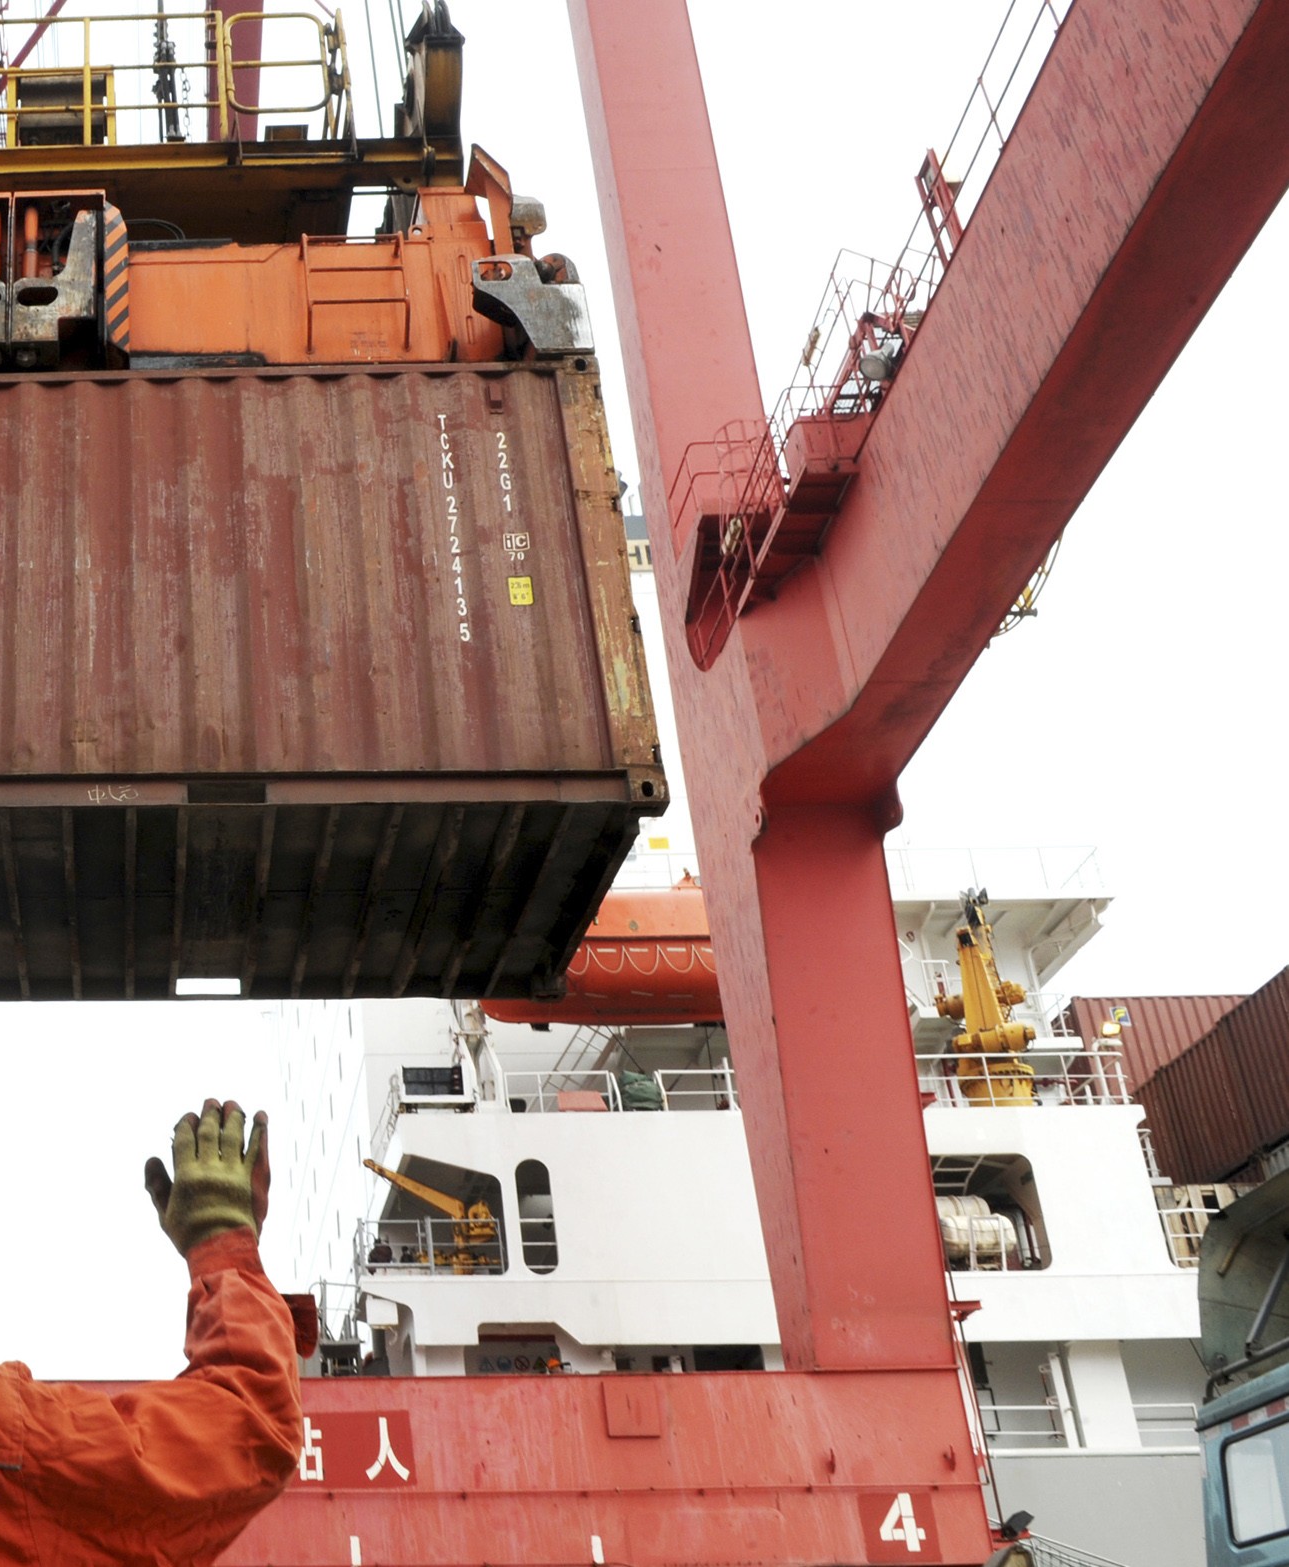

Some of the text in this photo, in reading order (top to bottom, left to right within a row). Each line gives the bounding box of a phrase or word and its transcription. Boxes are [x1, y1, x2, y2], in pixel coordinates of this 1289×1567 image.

[496, 432, 512, 512] 22G1
[509, 551, 525, 561] 70
[879, 1492, 927, 1552] 4
